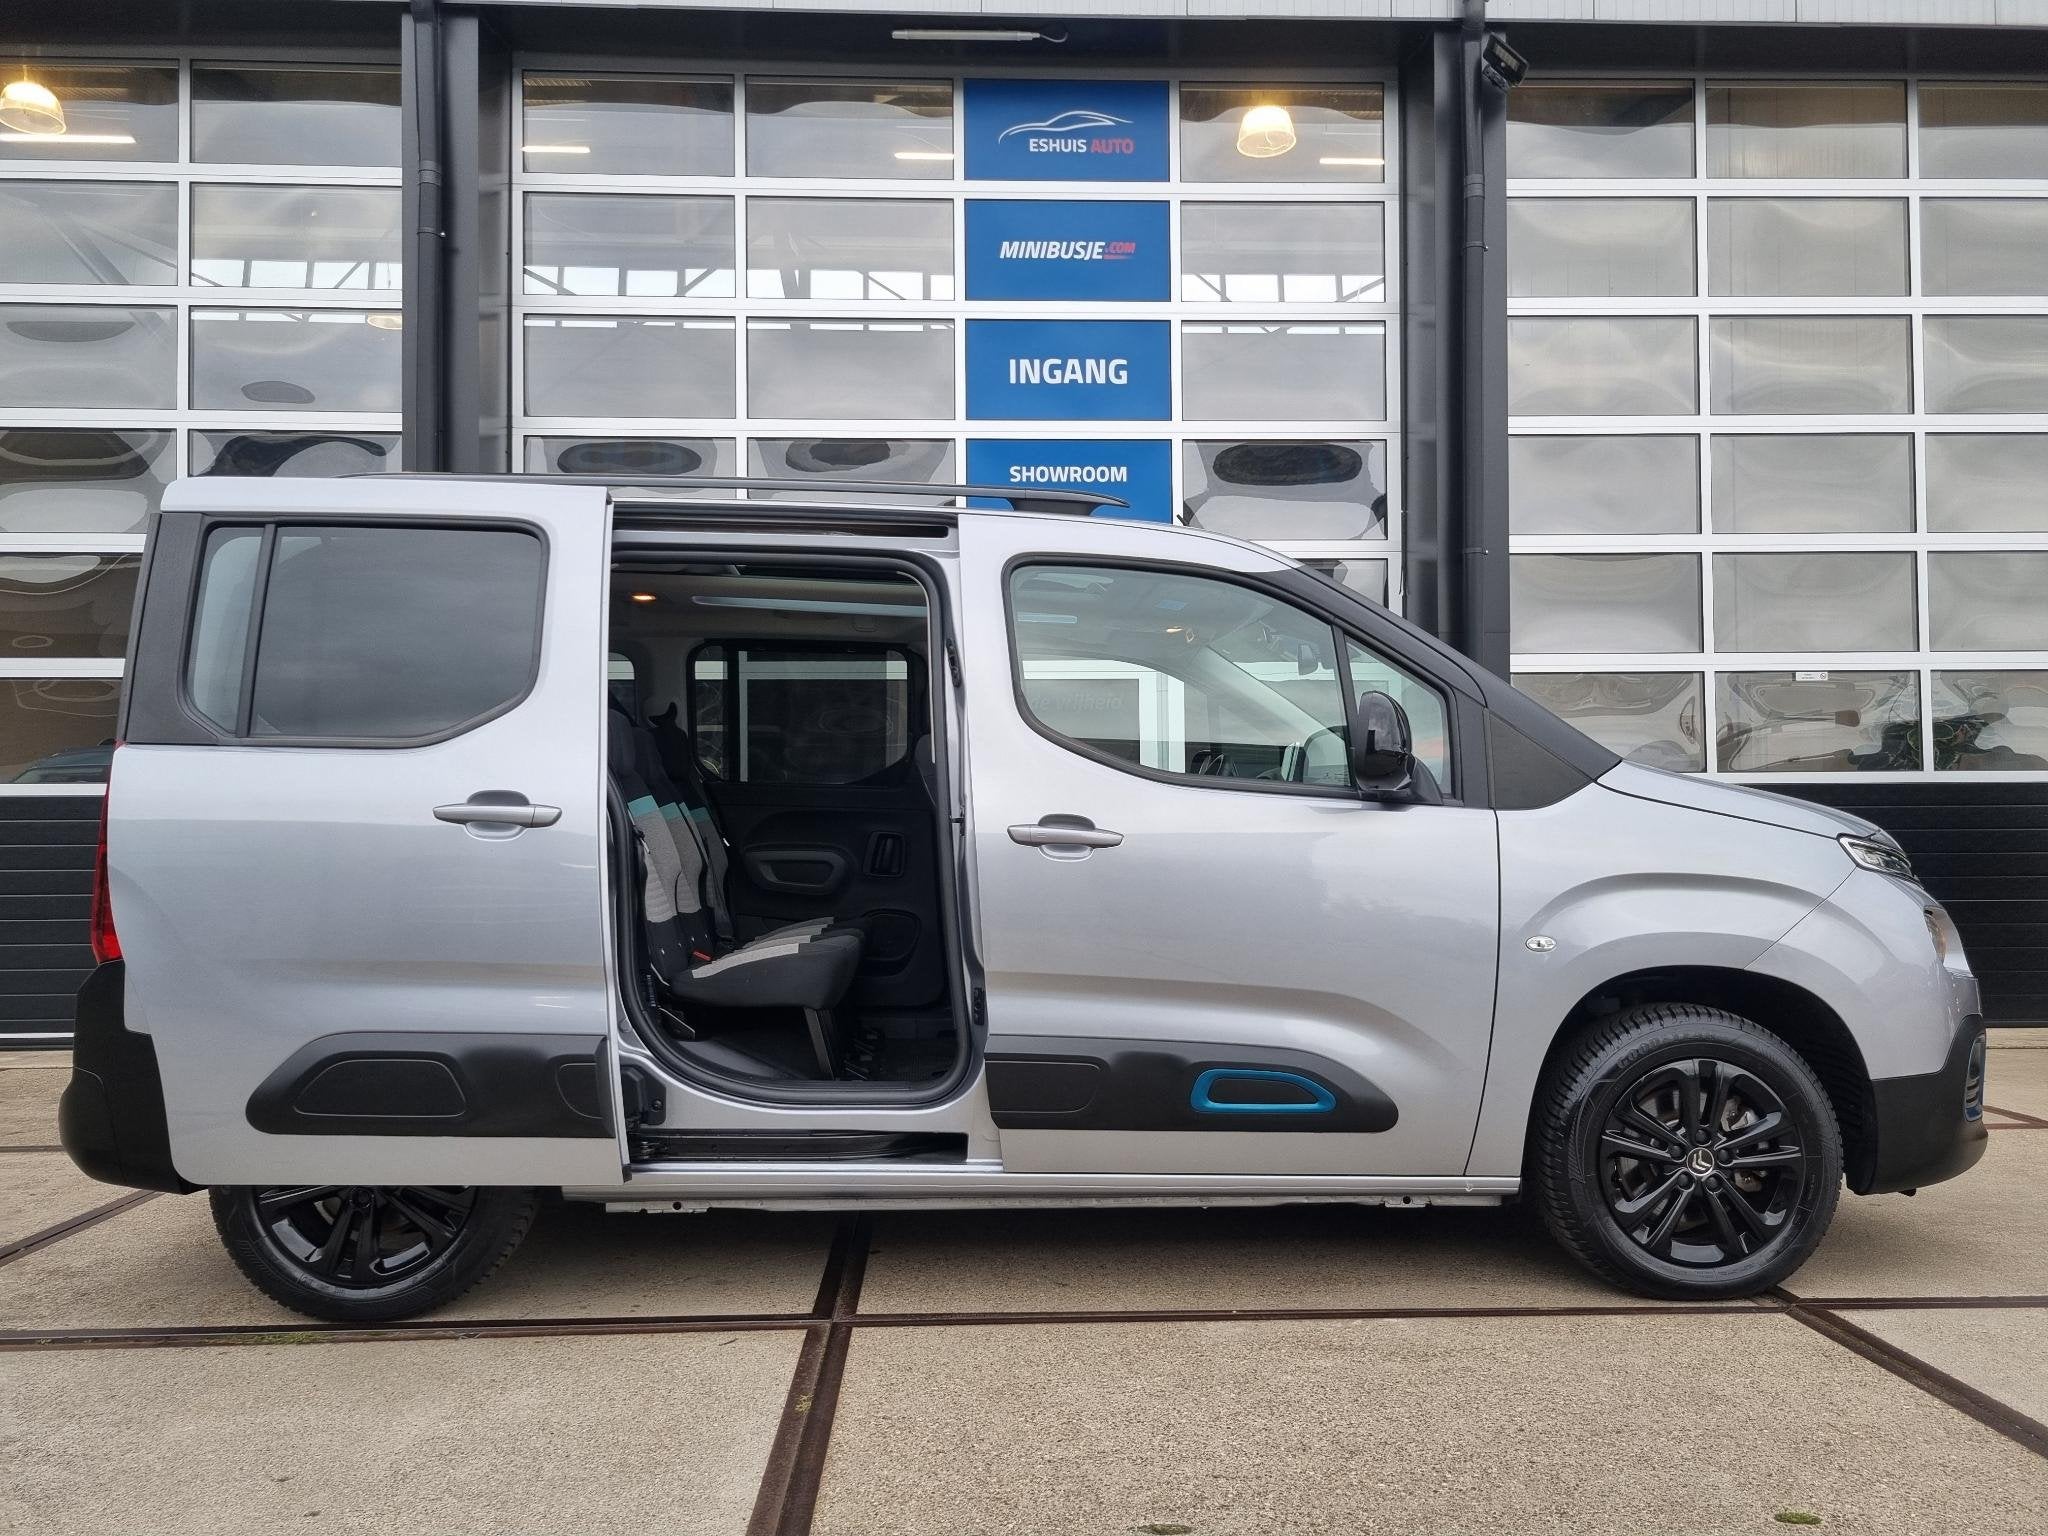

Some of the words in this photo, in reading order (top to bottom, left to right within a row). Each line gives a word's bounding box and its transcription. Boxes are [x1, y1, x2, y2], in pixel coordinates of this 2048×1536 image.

[1029, 138, 1087, 153] ESHUIS
[1090, 138, 1135, 154] AUTO
[1009, 358, 1128, 385] INGANG
[1009, 465, 1127, 483] SHOWROOM
